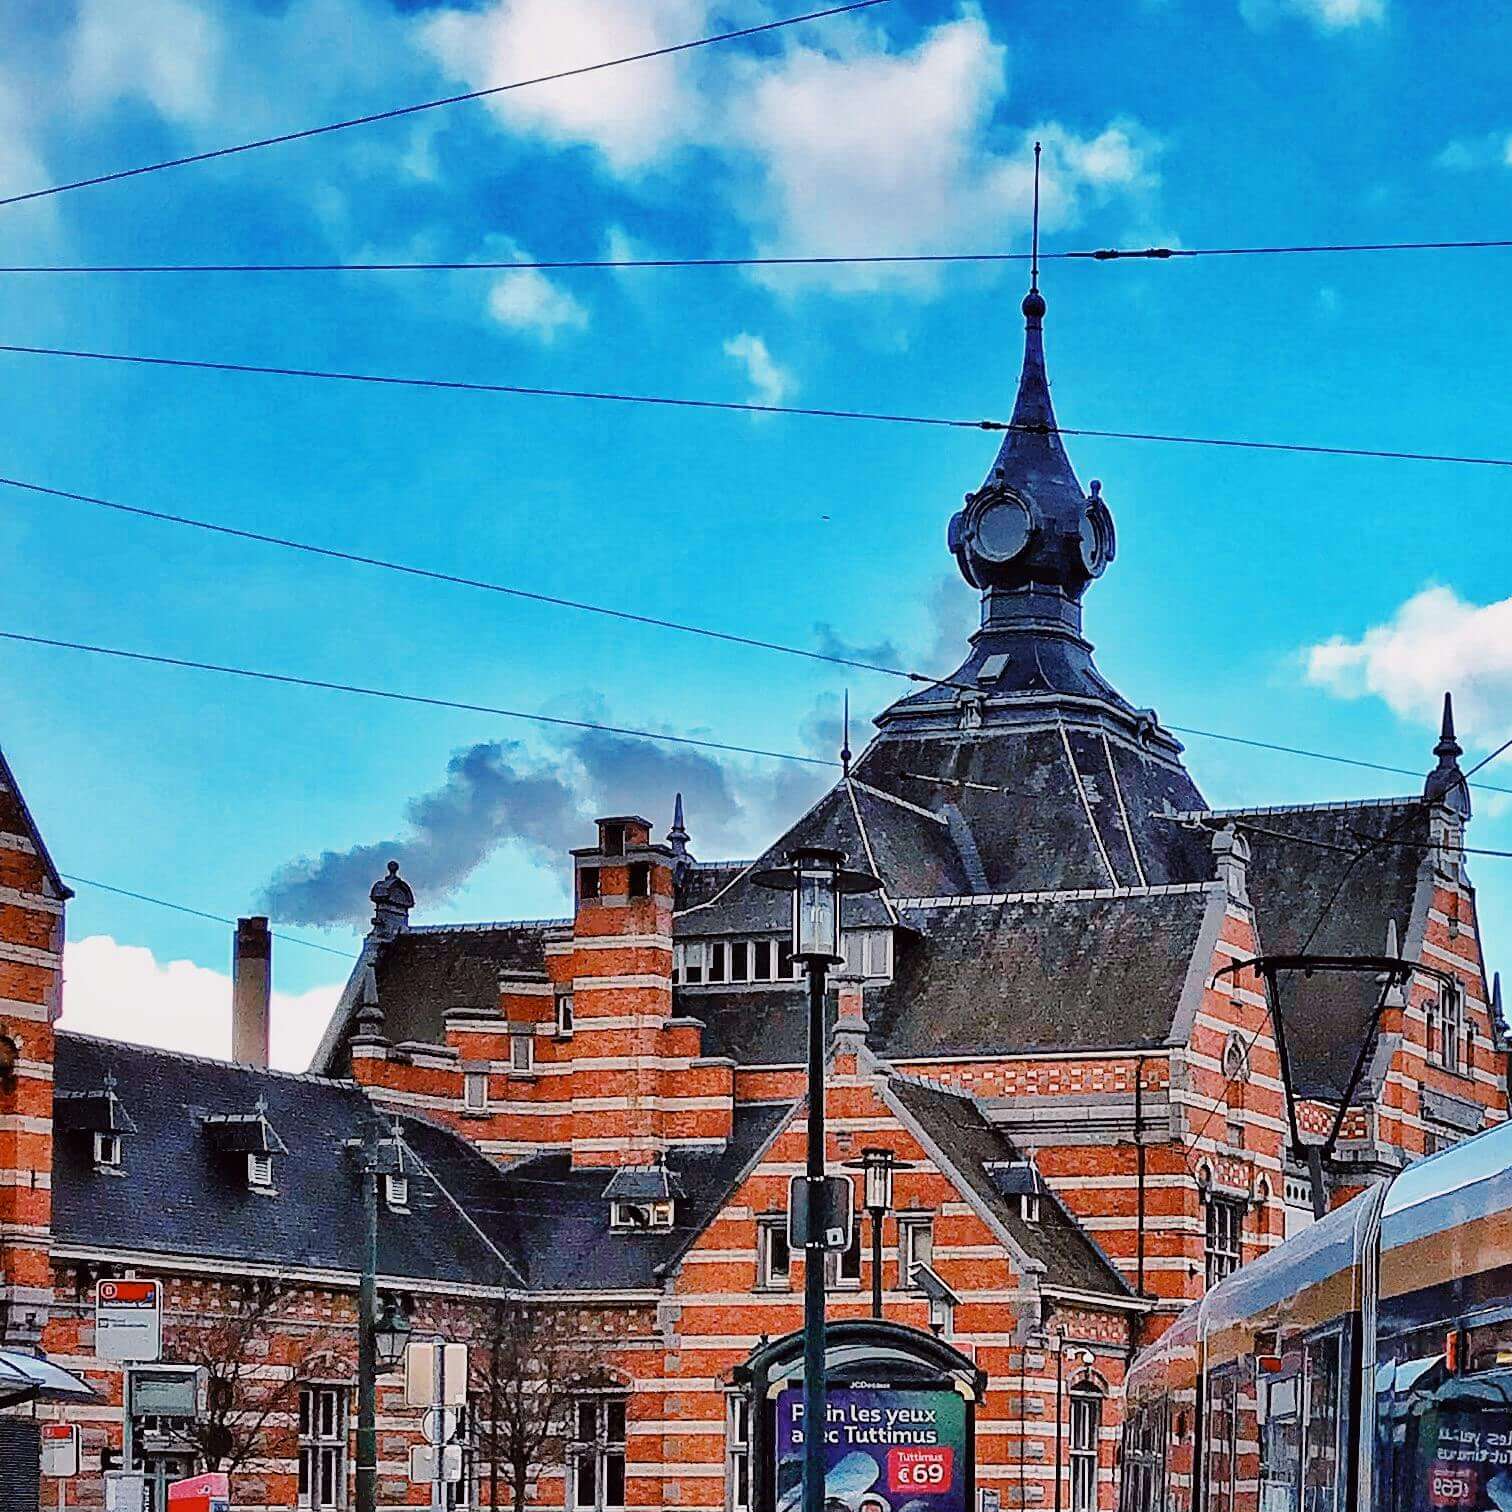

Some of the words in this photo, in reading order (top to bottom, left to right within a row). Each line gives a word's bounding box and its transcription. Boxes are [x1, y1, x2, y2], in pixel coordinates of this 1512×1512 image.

[791, 1404, 845, 1422] Pin
[851, 1404, 881, 1422] les
[886, 1408, 936, 1425] yeux
[844, 1425, 937, 1444] Tuttimus
[898, 1452, 943, 1462] Tuttimus
